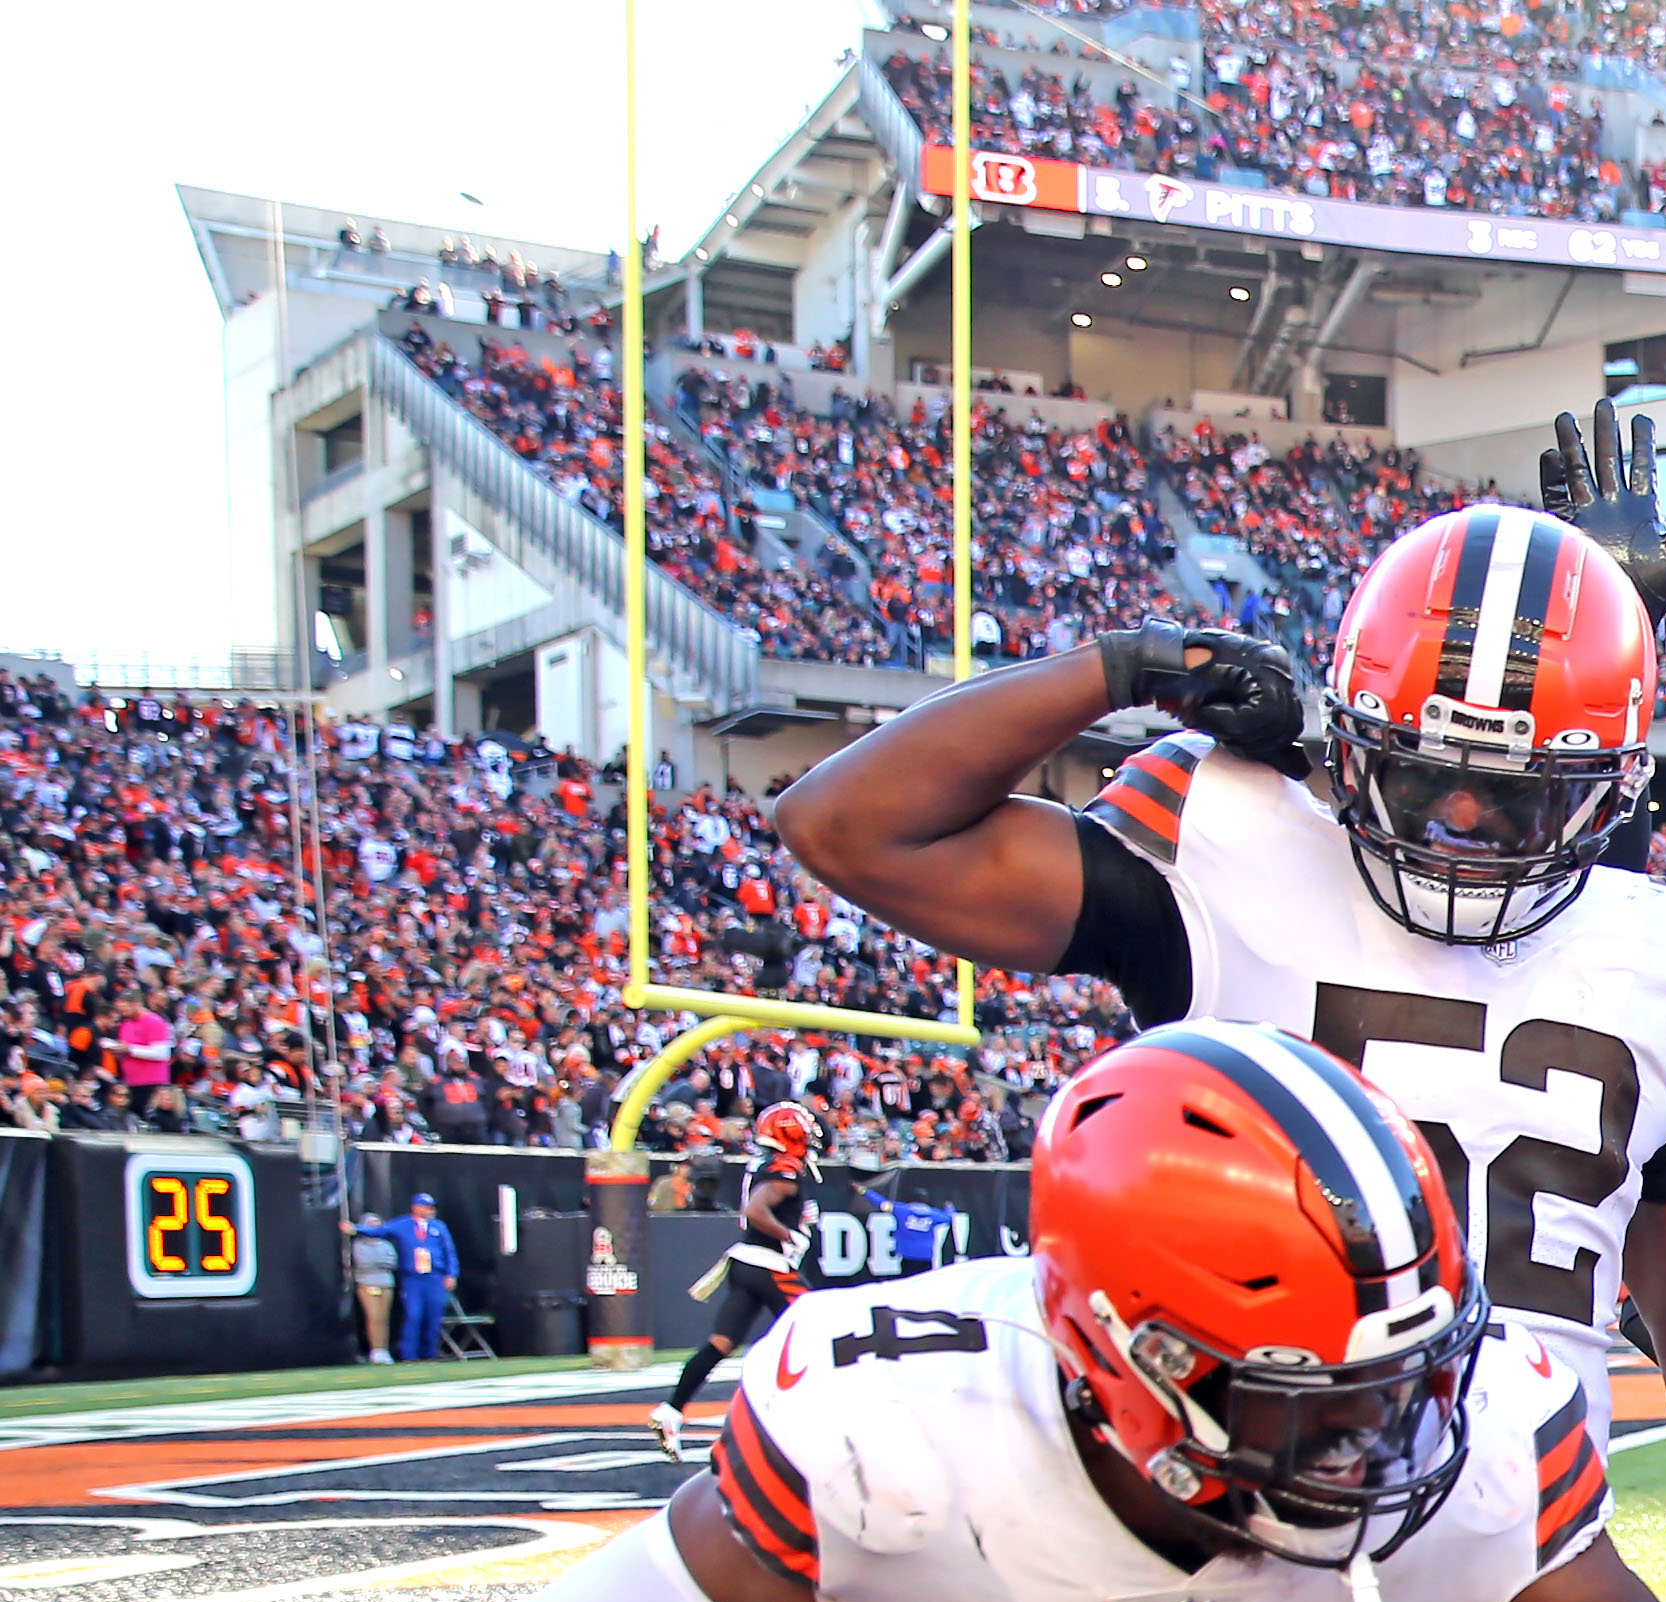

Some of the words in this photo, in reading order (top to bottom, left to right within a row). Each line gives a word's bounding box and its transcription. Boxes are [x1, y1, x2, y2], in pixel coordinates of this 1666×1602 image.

[1205, 189, 1316, 236] PITTS
[1451, 709, 1506, 733] BROWNS
[1312, 981, 1641, 1327] 52
[147, 1177, 238, 1273] 25
[832, 1305, 989, 1369] 4
